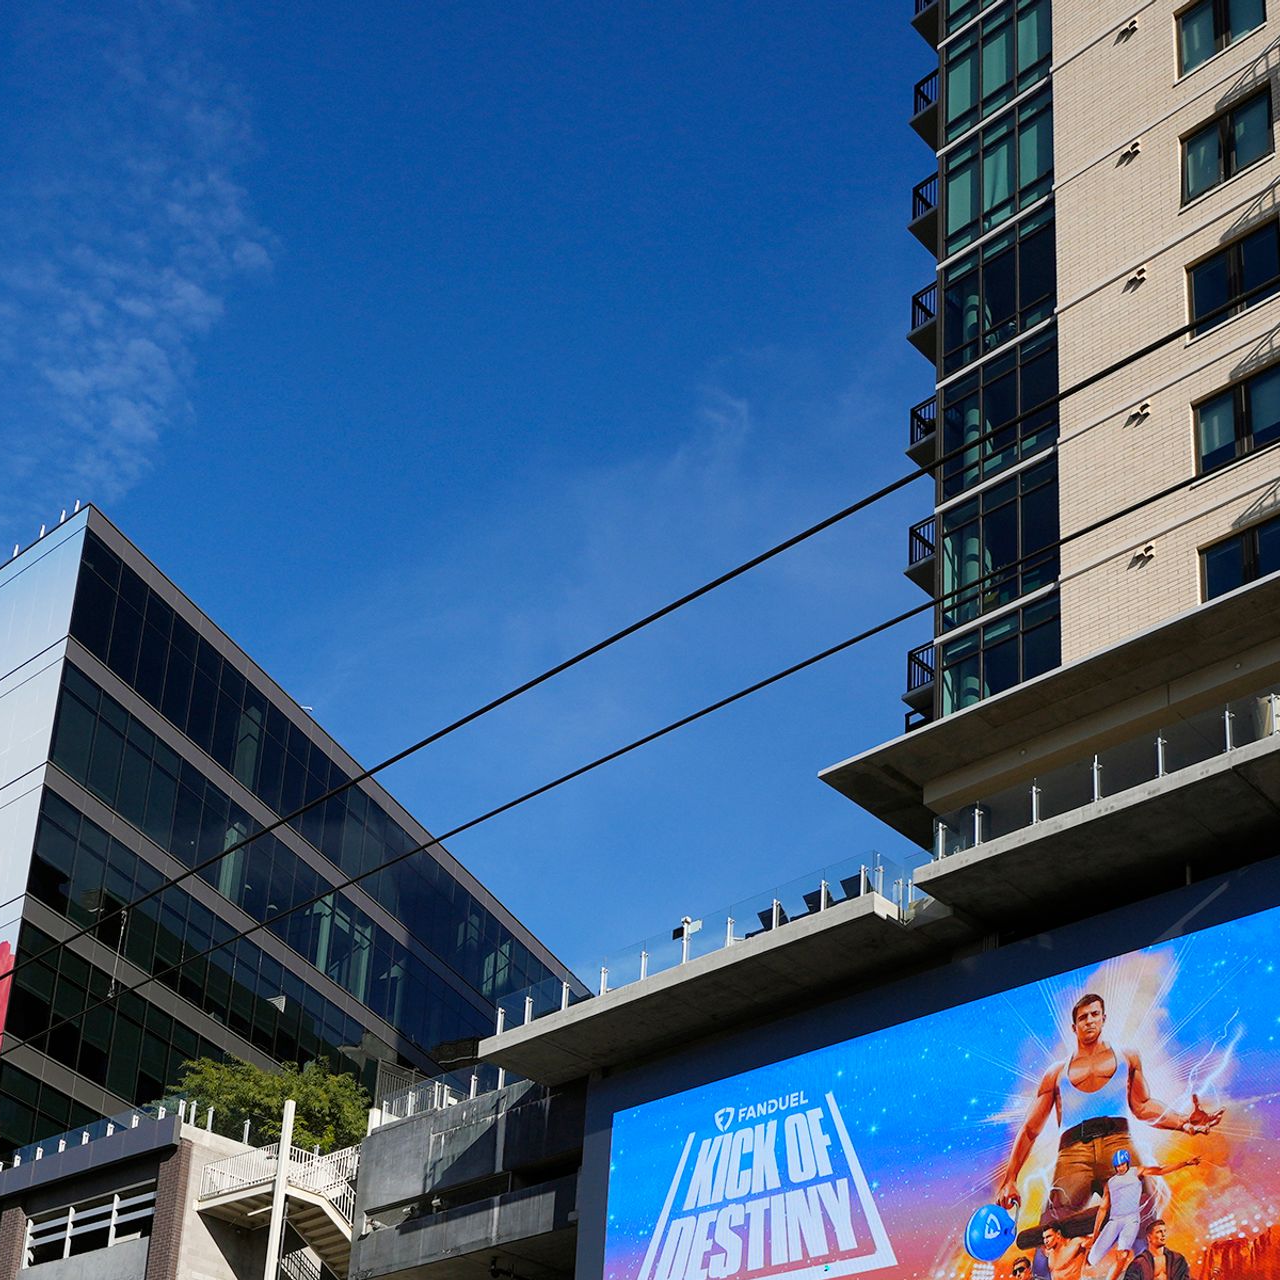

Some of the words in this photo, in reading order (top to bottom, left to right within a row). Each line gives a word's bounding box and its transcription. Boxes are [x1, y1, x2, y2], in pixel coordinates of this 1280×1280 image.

[738, 1091, 808, 1122] FANDUEL
[682, 1119, 782, 1212] KICK
[784, 1107, 834, 1183] OF
